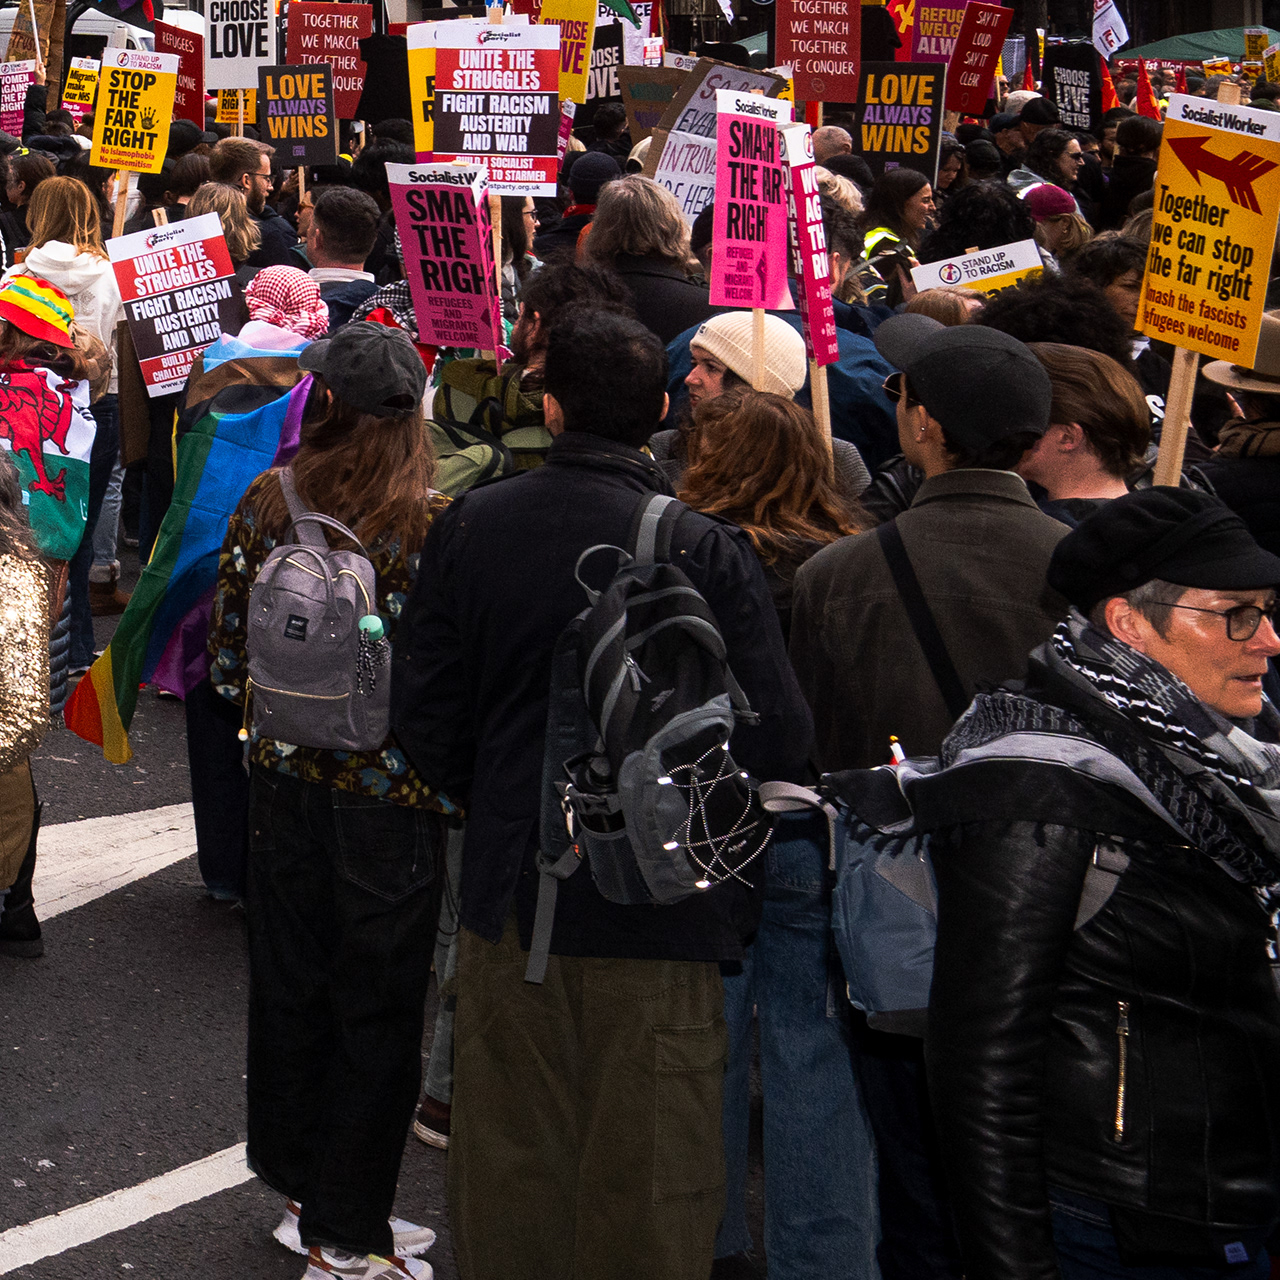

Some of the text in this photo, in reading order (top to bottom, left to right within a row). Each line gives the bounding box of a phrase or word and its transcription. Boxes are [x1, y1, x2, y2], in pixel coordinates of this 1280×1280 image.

[209, 0, 269, 23] CHOOSE
[790, 0, 849, 16] TOGETHER
[302, 13, 360, 30] TOGETHER
[790, 19, 849, 36] WE MARCH
[975, 10, 1001, 27] SAY IT
[162, 31, 195, 54] REFUGEES
[209, 22, 269, 59] LOVE
[300, 34, 360, 50] WE MARCH
[485, 30, 521, 39] Socialist
[972, 32, 992, 48] LOUD
[790, 39, 848, 56] TOGETHER
[130, 53, 160, 63] STAND UP
[130, 60, 162, 71] TO RACISM
[301, 54, 358, 70] TOGETHER
[458, 49, 535, 70] UNITE THE
[783, 59, 855, 76] WE CONQUER
[964, 51, 990, 68] SAY IT
[69, 69, 96, 83] Migrants
[109, 69, 156, 92] STOP
[452, 70, 541, 91] STRUGGLES
[959, 71, 981, 88] CLEAR
[1053, 66, 1091, 87] CHOOSE
[66, 82, 86, 92] make
[77, 91, 91, 102] NHS
[265, 73, 326, 101] LOVE
[864, 73, 936, 106] LOVE
[1055, 82, 1090, 111] LOVE
[0, 102, 25, 112] RIGHT
[107, 88, 140, 110] THE
[267, 98, 327, 116] ALWAYS
[442, 94, 485, 114] FIGHT
[489, 94, 550, 115] RACISM
[105, 107, 136, 129] FAR
[459, 114, 532, 134] AUSTERITY
[676, 108, 717, 137] EVEN
[862, 104, 933, 126] ALWAYS
[267, 114, 329, 139] WINS
[101, 127, 159, 151] RIGHT
[462, 134, 528, 153] AND WAR
[728, 120, 775, 164] SMASH
[861, 124, 931, 155] WINS
[99, 155, 153, 169] No antisemitism
[100, 146, 155, 161] No Islamophobia
[490, 157, 535, 169] SOCIALIST
[491, 170, 547, 182] TO STARMER
[727, 161, 758, 201] THE
[1158, 184, 1230, 229] Together
[726, 202, 769, 243] RIGHT
[153, 228, 186, 240] Socialist
[411, 224, 471, 260] THE
[726, 246, 754, 259] REFUGEES
[1154, 221, 1254, 274] we can stop
[133, 241, 207, 277] UNITE THE
[961, 251, 1006, 270] STAND UP
[133, 259, 217, 297] STRUGGLES
[965, 260, 1016, 279] TO RACISM
[1149, 246, 1253, 302] the far right
[724, 273, 754, 287] MIGRANTS
[131, 279, 233, 322] FIGHT RACISM
[428, 295, 474, 309] REFUGEES
[724, 287, 754, 301] WELCOME
[153, 302, 220, 335] AUSTERITY
[443, 308, 462, 319] AND
[1177, 293, 1248, 330] the fascists
[431, 318, 479, 332] MIGRANTS
[161, 321, 223, 352] AND WAR
[434, 329, 480, 343] WELCOME
[1187, 323, 1240, 353] welcome
[161, 354, 186, 368] BUILD
